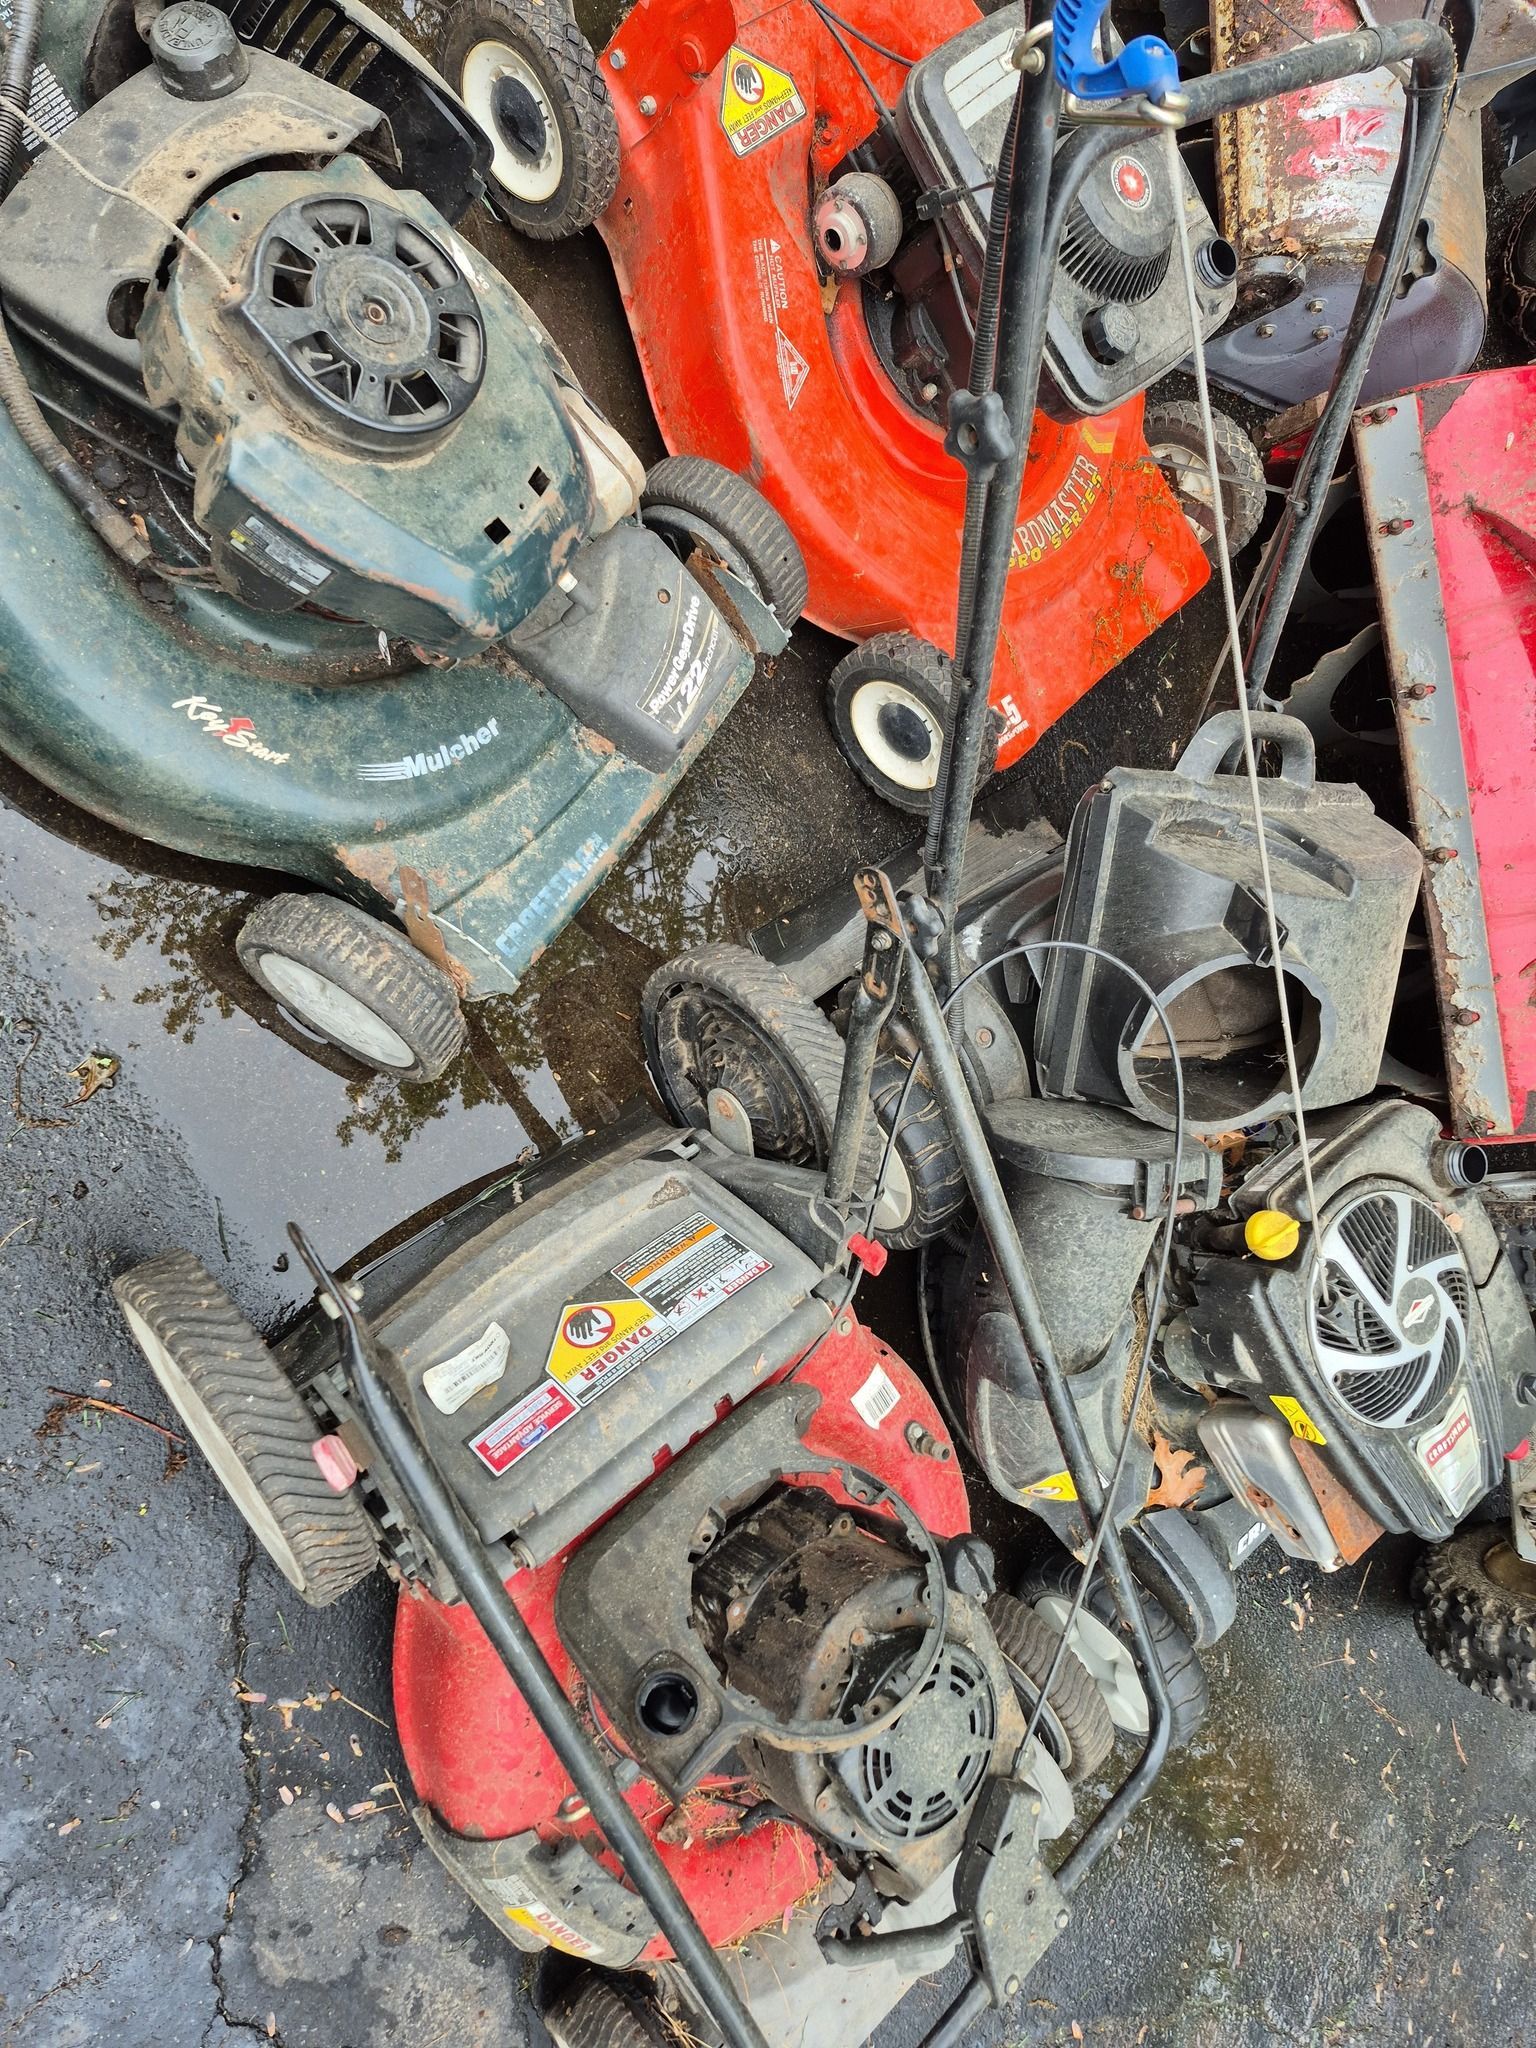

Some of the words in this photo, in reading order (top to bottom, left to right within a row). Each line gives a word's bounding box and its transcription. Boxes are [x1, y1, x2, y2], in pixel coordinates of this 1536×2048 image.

[761, 93, 781, 110] HANDS
[777, 86, 793, 100] KEEP
[726, 117, 743, 133] AWAY
[735, 98, 798, 148] DANGER
[740, 110, 756, 123] FEET
[752, 104, 764, 115] and
[753, 254, 761, 280] ENGINE
[758, 253, 766, 276] BLADE
[762, 278, 770, 301] TURNS
[773, 254, 788, 309] CAUTION
[757, 281, 763, 289] IS
[771, 273, 780, 308] MUFFLER
[759, 290, 768, 322] RUNNING
[1011, 454, 1098, 557] ARDMASTER
[1051, 472, 1102, 549] SERIES
[647, 666, 680, 715] Power
[669, 632, 693, 672] Gear
[681, 596, 701, 637] Drive
[678, 657, 708, 705] 22
[170, 695, 229, 733] Key
[221, 729, 290, 765] Start
[400, 716, 501, 778] Mulcher
[645, 1240, 687, 1272] WARNING
[723, 1266, 759, 1293] DANGER
[609, 1324, 634, 1343] HANDS
[632, 1312, 650, 1327] KEEP
[578, 1324, 653, 1382] DANGER
[581, 1348, 600, 1365] FEET
[598, 1339, 611, 1352] and
[562, 1361, 583, 1380] AWAY
[532, 1399, 563, 1426] SERVICE
[490, 1422, 534, 1460] ADVANTAGE
[1427, 1417, 1467, 1462] CRAFTSMAN
[535, 1910, 592, 1953] DANGER
